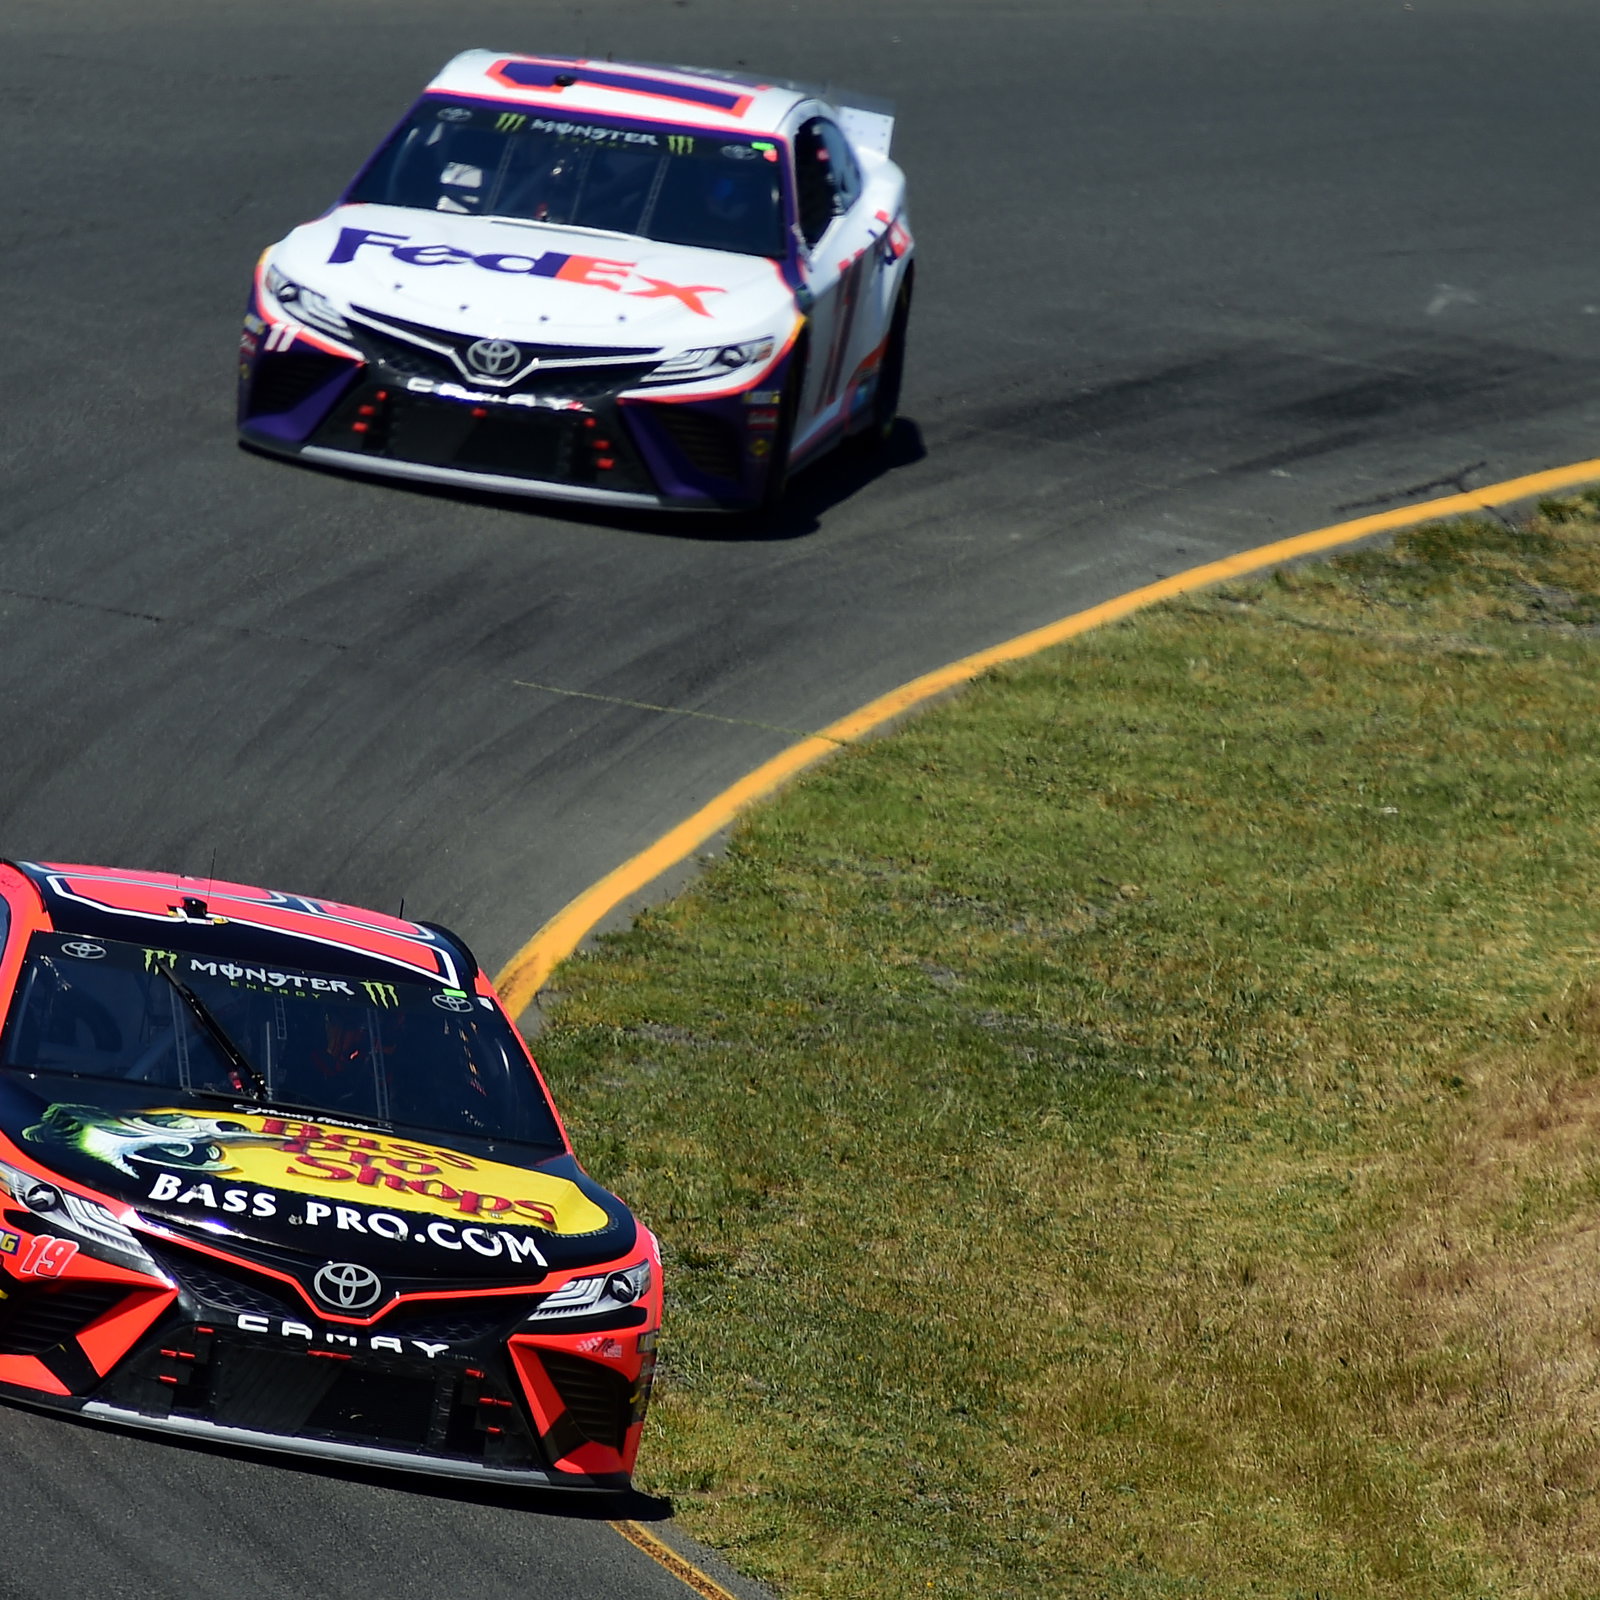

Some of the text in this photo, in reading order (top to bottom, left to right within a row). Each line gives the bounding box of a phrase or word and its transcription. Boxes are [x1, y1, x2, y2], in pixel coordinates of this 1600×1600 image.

[530, 118, 658, 146] MONSTER
[326, 226, 728, 319] FedEx
[190, 958, 356, 996] MONSTER
[229, 980, 321, 999] ENERGY
[260, 1116, 478, 1172] Bass
[278, 1134, 444, 1176] Pro
[285, 1155, 559, 1231] Shops
[147, 1173, 549, 1267] BASS PRO.COM
[19, 1233, 80, 1279] 19
[237, 1313, 451, 1359] CAMRY
